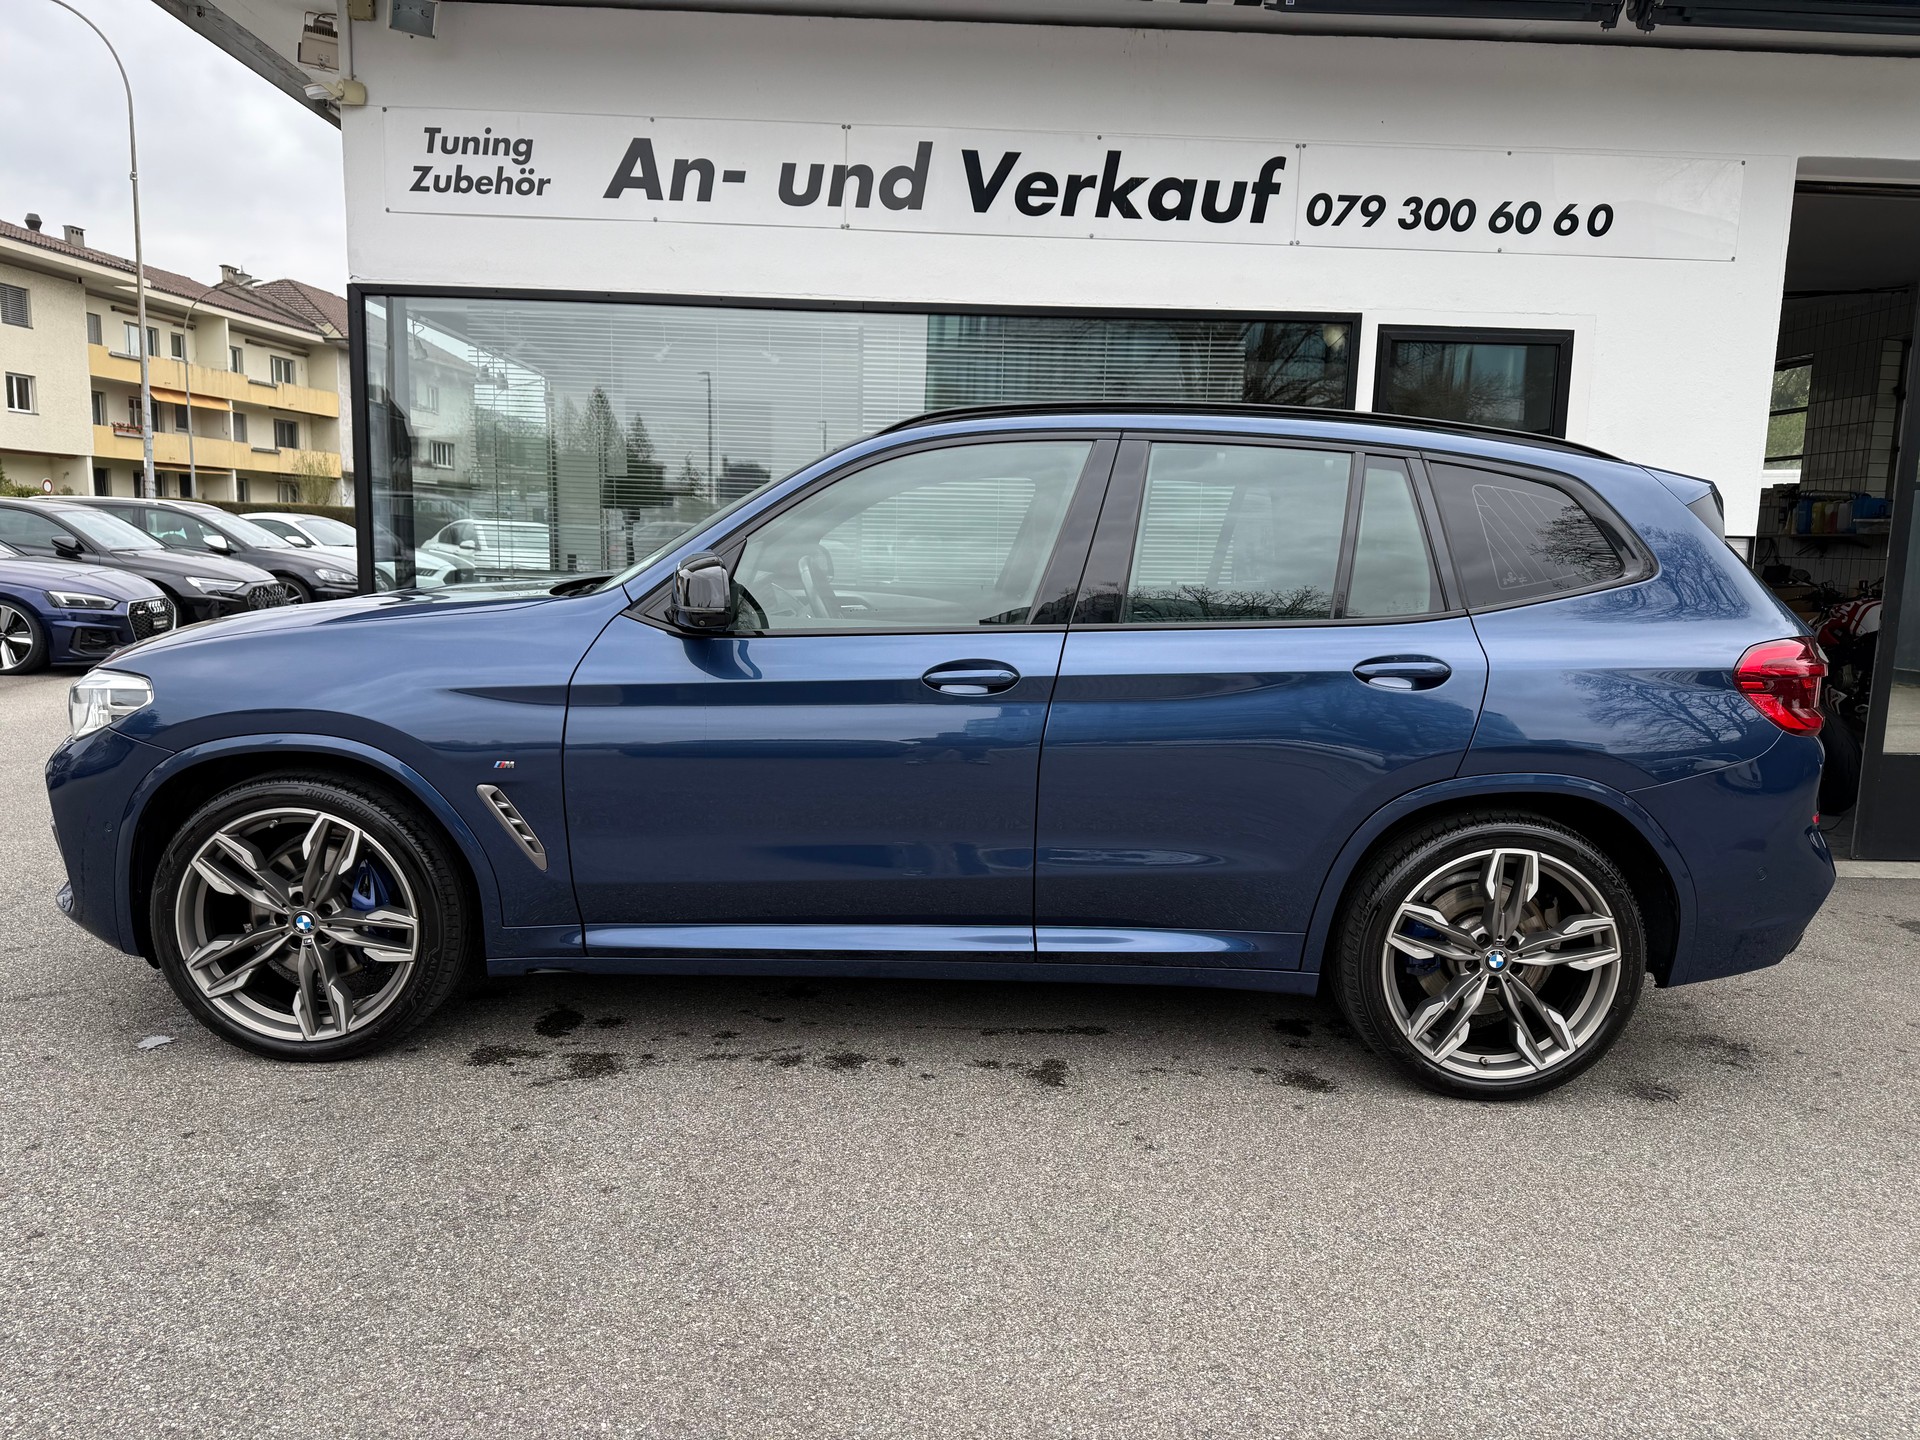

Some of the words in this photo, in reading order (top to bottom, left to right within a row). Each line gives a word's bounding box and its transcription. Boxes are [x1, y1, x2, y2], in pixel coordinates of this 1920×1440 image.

[423, 126, 534, 166] Tuning
[409, 165, 552, 196] Zubehör
[602, 137, 746, 203] An-
[778, 141, 934, 214] und
[961, 149, 1287, 225] Verkauf
[1306, 192, 1387, 228] 079
[1397, 196, 1477, 233] 300
[1488, 200, 1542, 235] 60
[1553, 203, 1614, 238] 60
